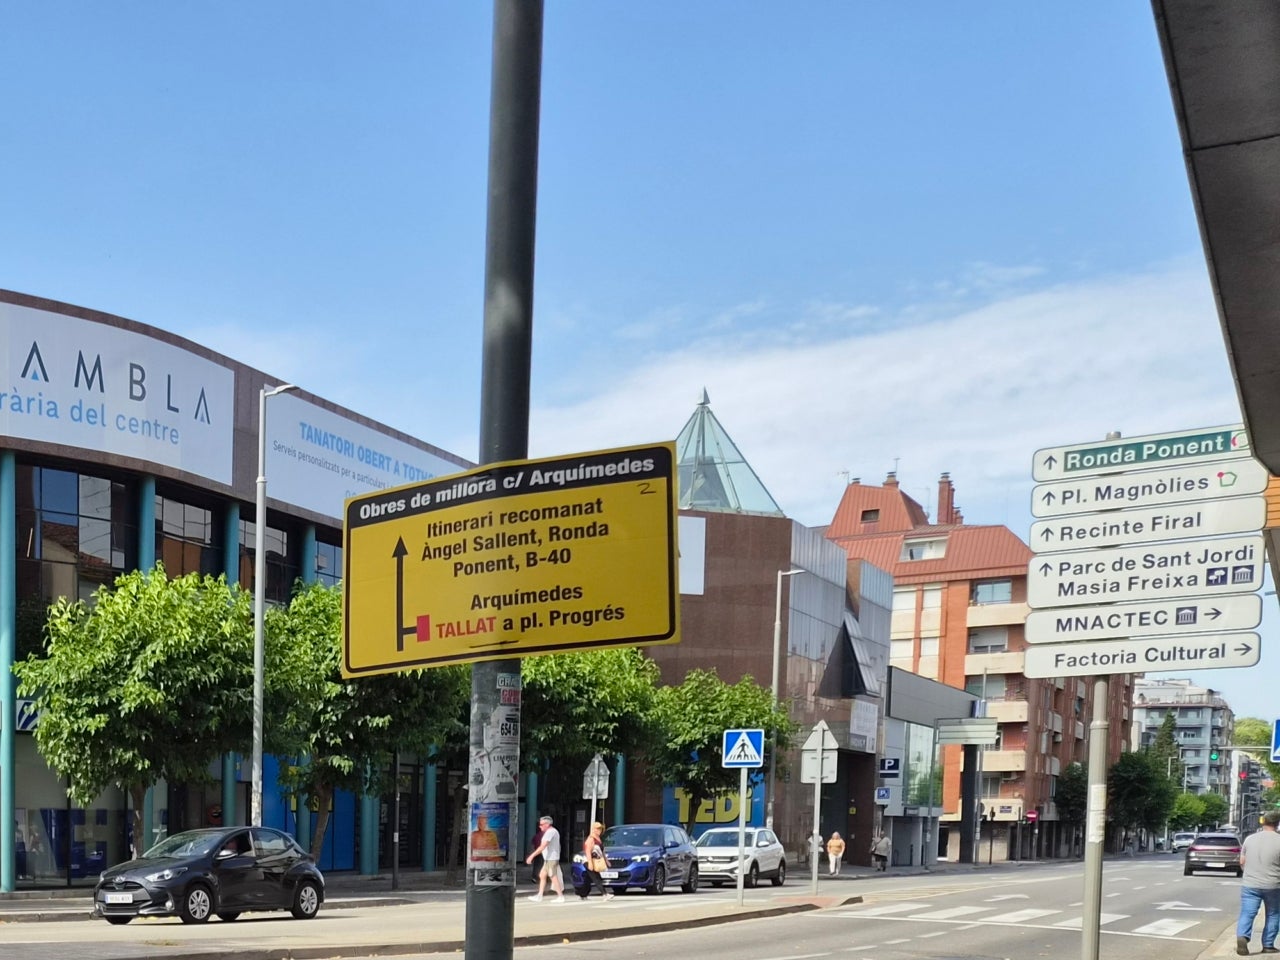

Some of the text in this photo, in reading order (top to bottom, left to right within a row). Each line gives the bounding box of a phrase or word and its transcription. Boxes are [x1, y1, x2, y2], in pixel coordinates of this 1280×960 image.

[70, 399, 107, 427] del
[116, 411, 180, 445] centre
[273, 440, 297, 459] Serveis
[298, 450, 340, 475] personalitzats
[341, 467, 351, 478] per
[299, 421, 355, 459] TANATORI
[357, 445, 393, 473] OBERT
[393, 459, 400, 476] A
[1066, 435, 1225, 469] Ronda Ponent
[359, 457, 655, 521] Obres de millora c/ Arquímedes
[1061, 477, 1209, 505] Pl. Magnòlies
[427, 497, 603, 539] Itinerari recomanat
[1060, 512, 1202, 541] Recinte Firal
[421, 521, 609, 562] Àngel Sallent, Ronda
[453, 547, 571, 578] Ponent, B-40
[1058, 545, 1255, 577] Parc de Sant Jordi
[471, 583, 583, 611] Arquímedes
[1058, 573, 1198, 597] Masia Freixa
[436, 603, 625, 639] TALLAT a pl. Progrés
[1056, 610, 1169, 633] MNACTEC
[1055, 643, 1226, 668] Factoria Cultural
